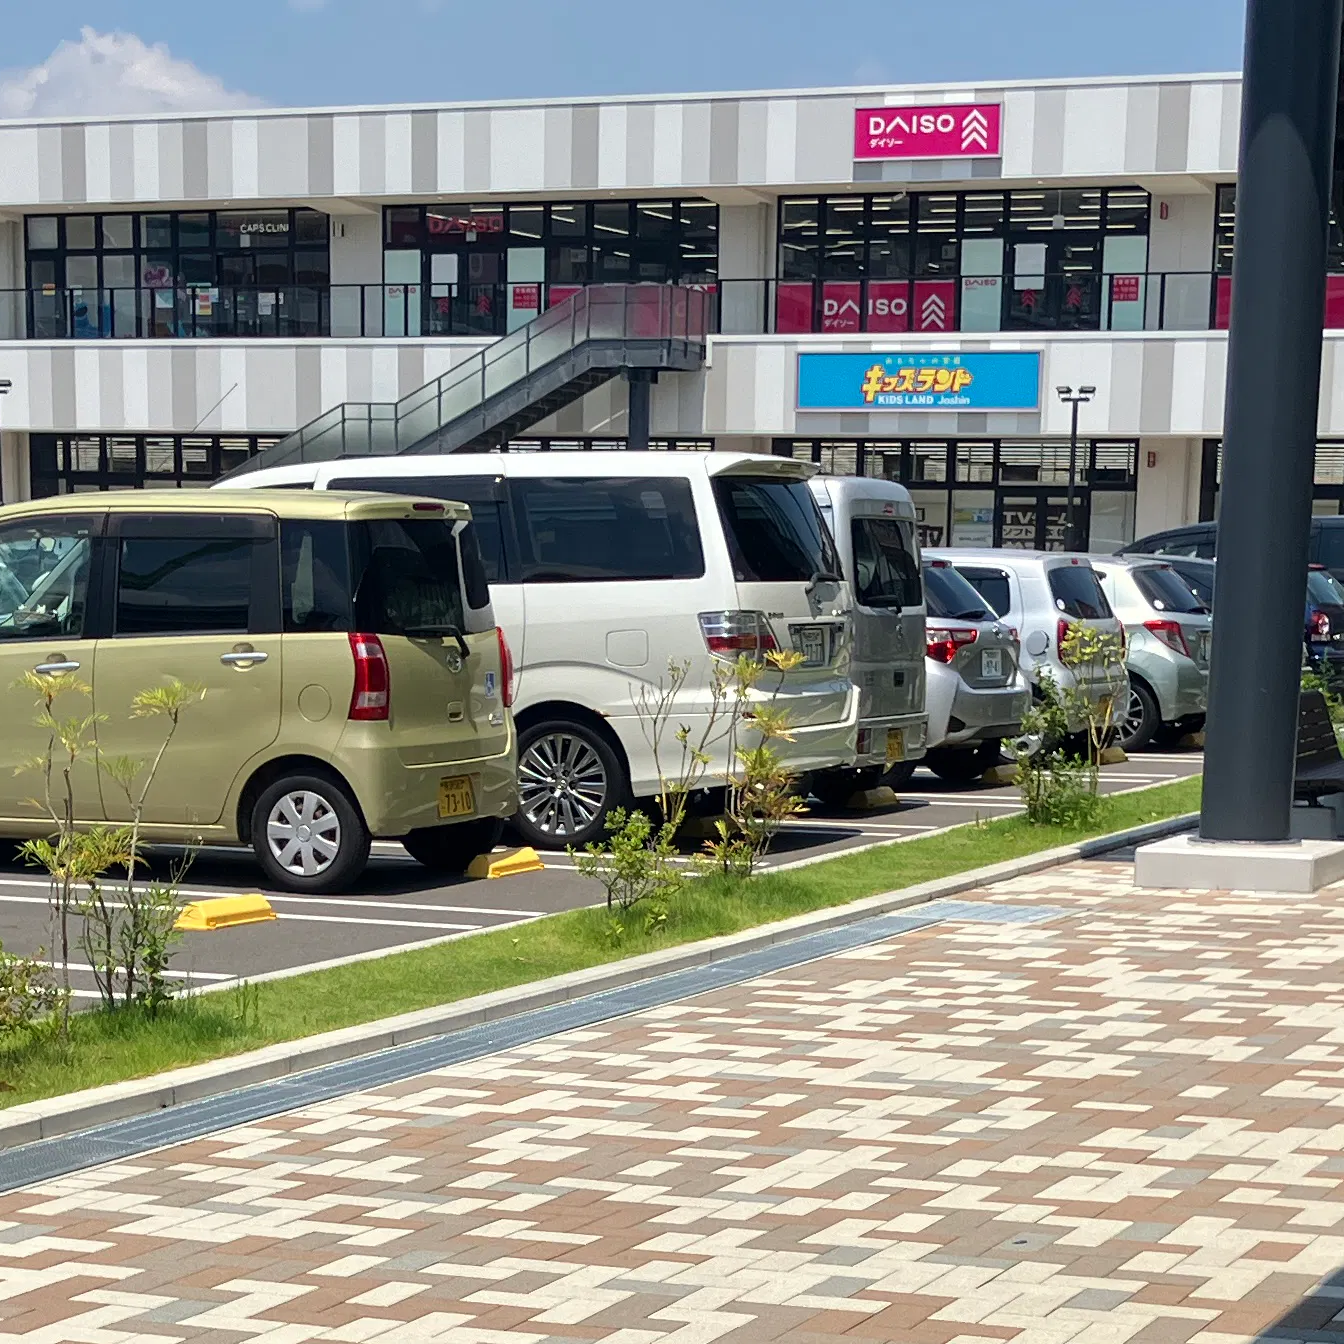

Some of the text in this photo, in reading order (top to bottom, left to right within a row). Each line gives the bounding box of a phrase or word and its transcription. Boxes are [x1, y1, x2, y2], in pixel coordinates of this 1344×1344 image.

[869, 114, 955, 136] DAISO
[869, 138, 903, 149] ダイソー
[240, 223, 264, 233] CAPS
[824, 299, 906, 316] DAISO
[862, 365, 973, 403] キッズランド
[878, 395, 970, 405] KIDS LAND Joshin
